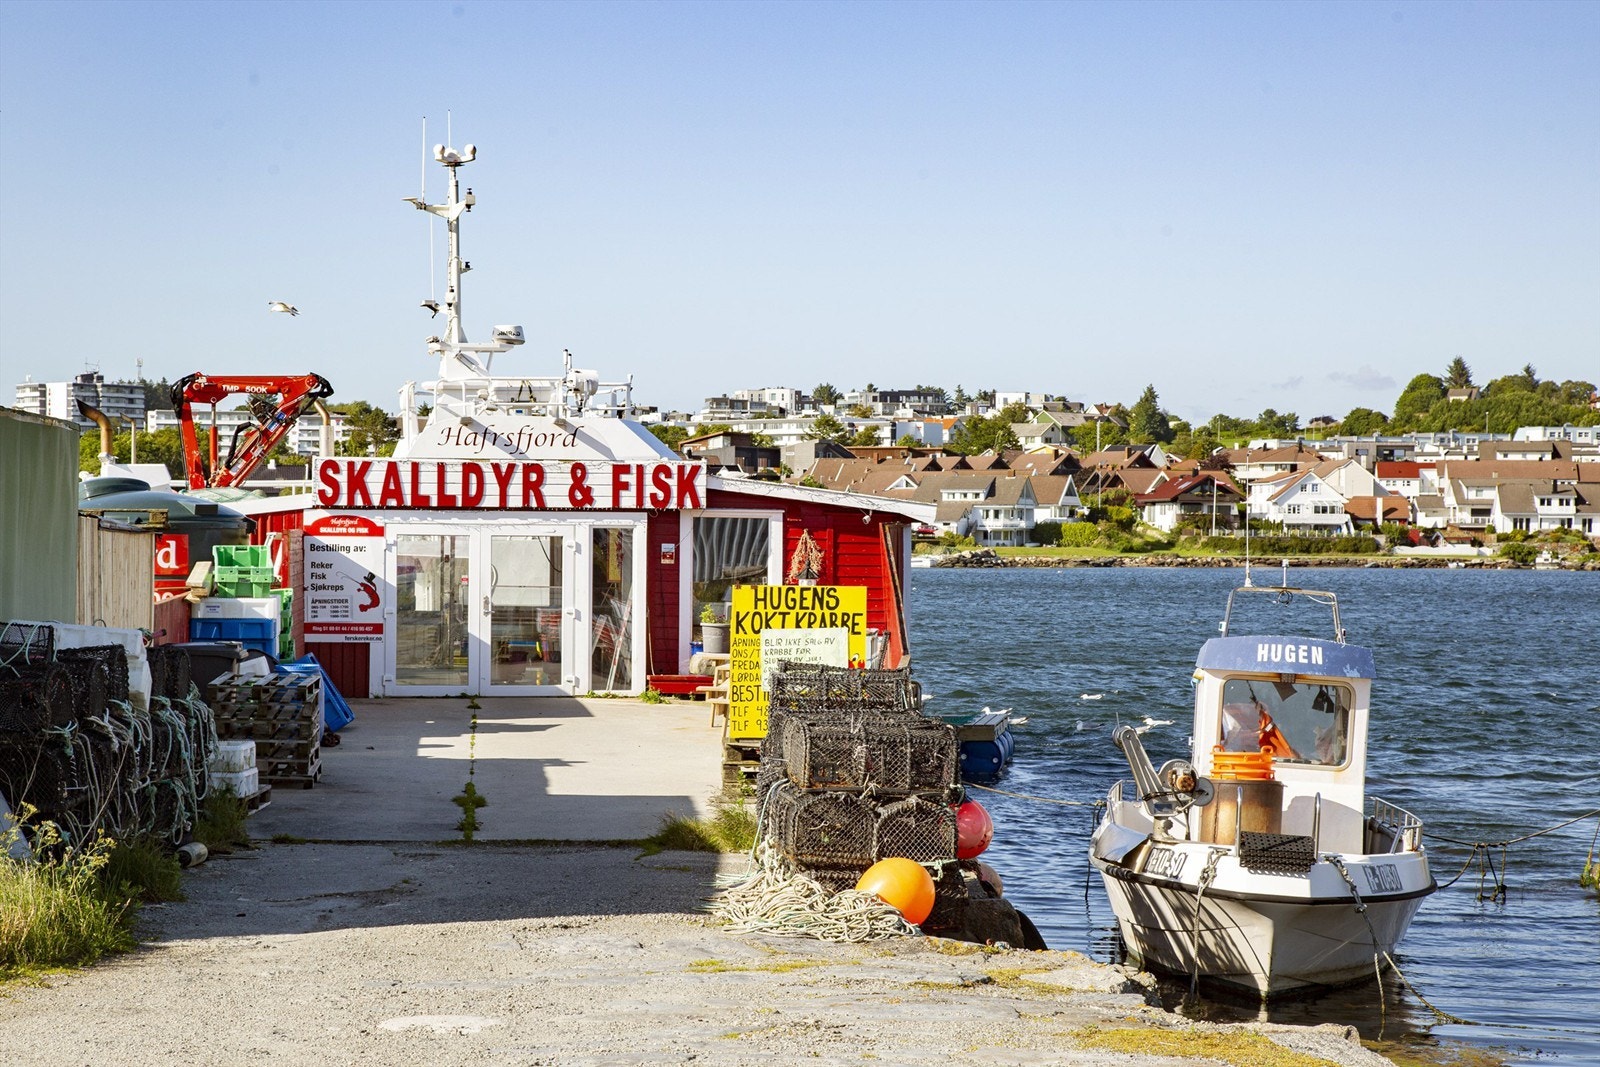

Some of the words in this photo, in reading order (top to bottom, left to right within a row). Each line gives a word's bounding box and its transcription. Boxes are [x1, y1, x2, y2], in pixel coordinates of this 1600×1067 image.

[222, 384, 240, 392] TMP
[245, 385, 268, 394] 500K
[437, 424, 585, 455] Hafrsfjord
[317, 459, 547, 508] SKALLDYR
[568, 462, 595, 508] &
[611, 463, 702, 509] FISK
[320, 526, 347, 534] SKALLDYR
[347, 526, 356, 534] OG
[356, 526, 369, 534] FISK
[310, 543, 351, 554] Bestilling
[156, 540, 179, 569] d
[310, 561, 333, 569] Reker
[310, 572, 327, 580] Fisk
[310, 583, 344, 592] Sjøkreps
[735, 611, 791, 635] KOKT
[795, 611, 864, 635] KRABBE
[764, 638, 783, 647] BLIR
[784, 638, 801, 647] IKKE
[824, 637, 835, 645] AV
[764, 648, 792, 657] KRABBE
[1257, 643, 1323, 665] HUGEN
[731, 706, 749, 717] TLF
[731, 720, 749, 731] TLF
